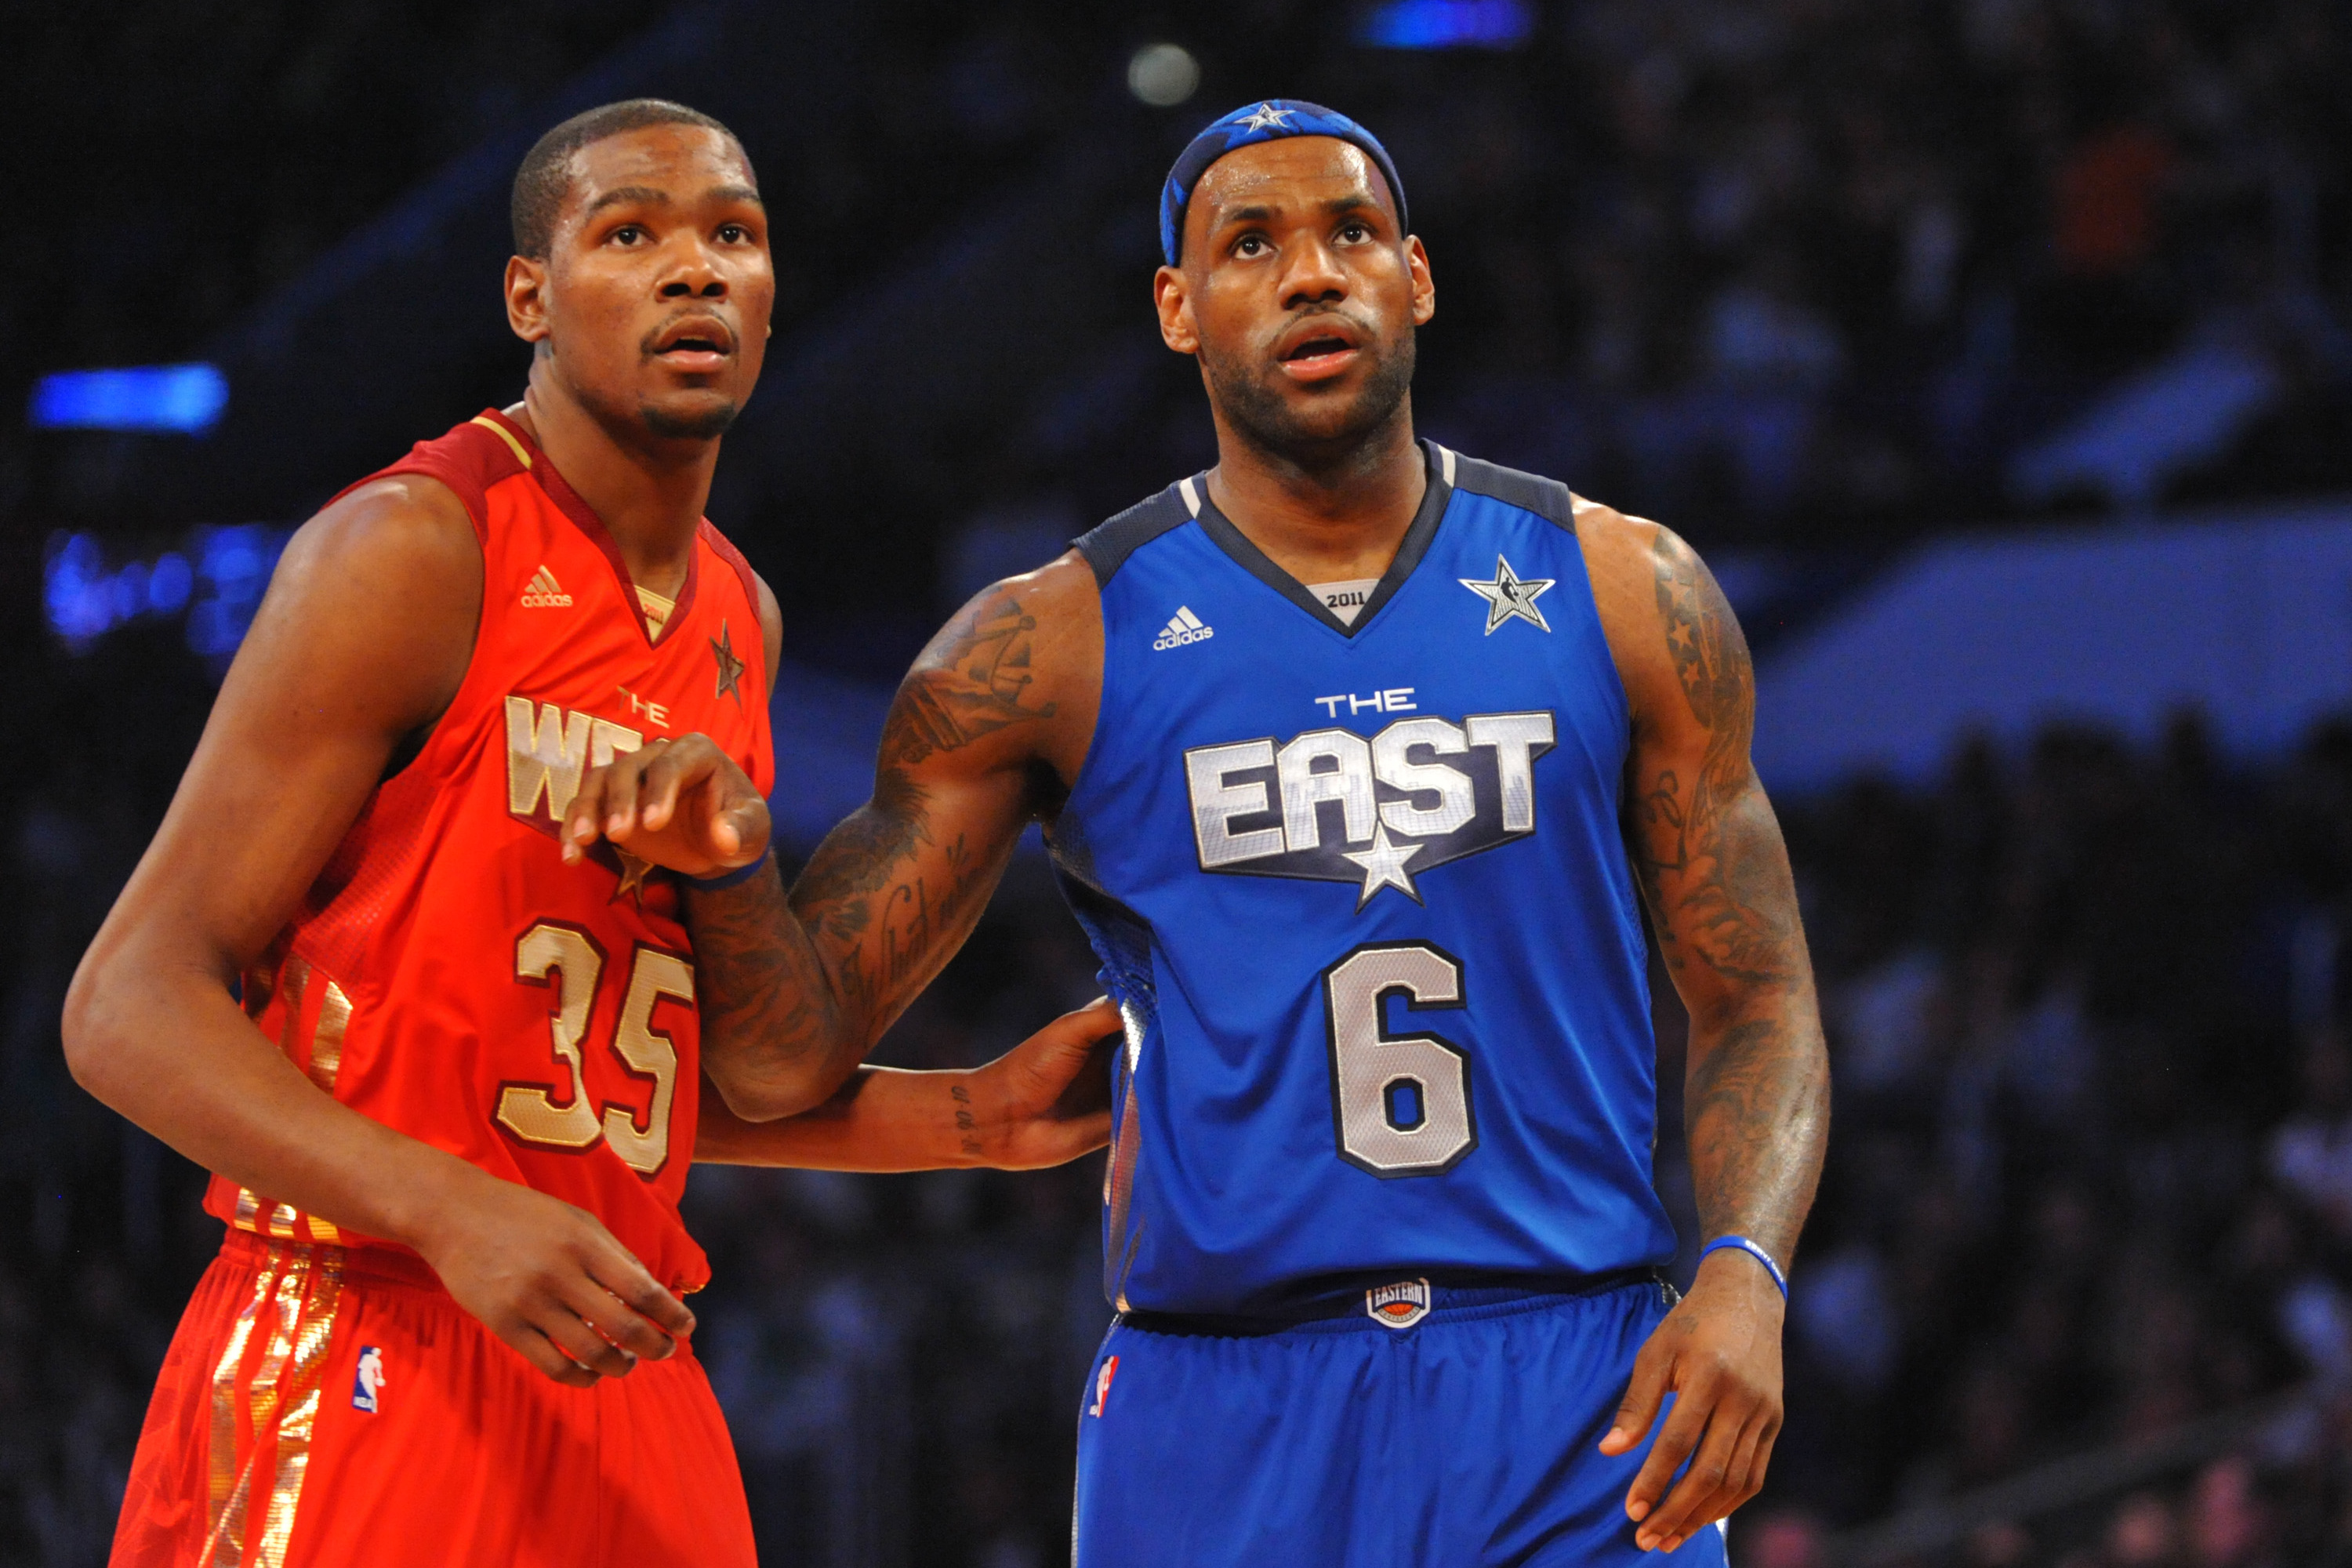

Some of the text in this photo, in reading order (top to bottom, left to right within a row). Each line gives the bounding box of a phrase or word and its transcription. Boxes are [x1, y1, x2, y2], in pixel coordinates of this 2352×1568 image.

[521, 591, 573, 608] adidas
[1326, 591, 1365, 608] 2011
[1153, 626, 1214, 651] adidas
[616, 685, 670, 729] THE
[1315, 688, 1417, 718] THE
[1185, 712, 1555, 869] EAST
[494, 920, 695, 1178] 35
[1324, 943, 1475, 1174] 6
[1374, 1281, 1423, 1308] EASTERN
